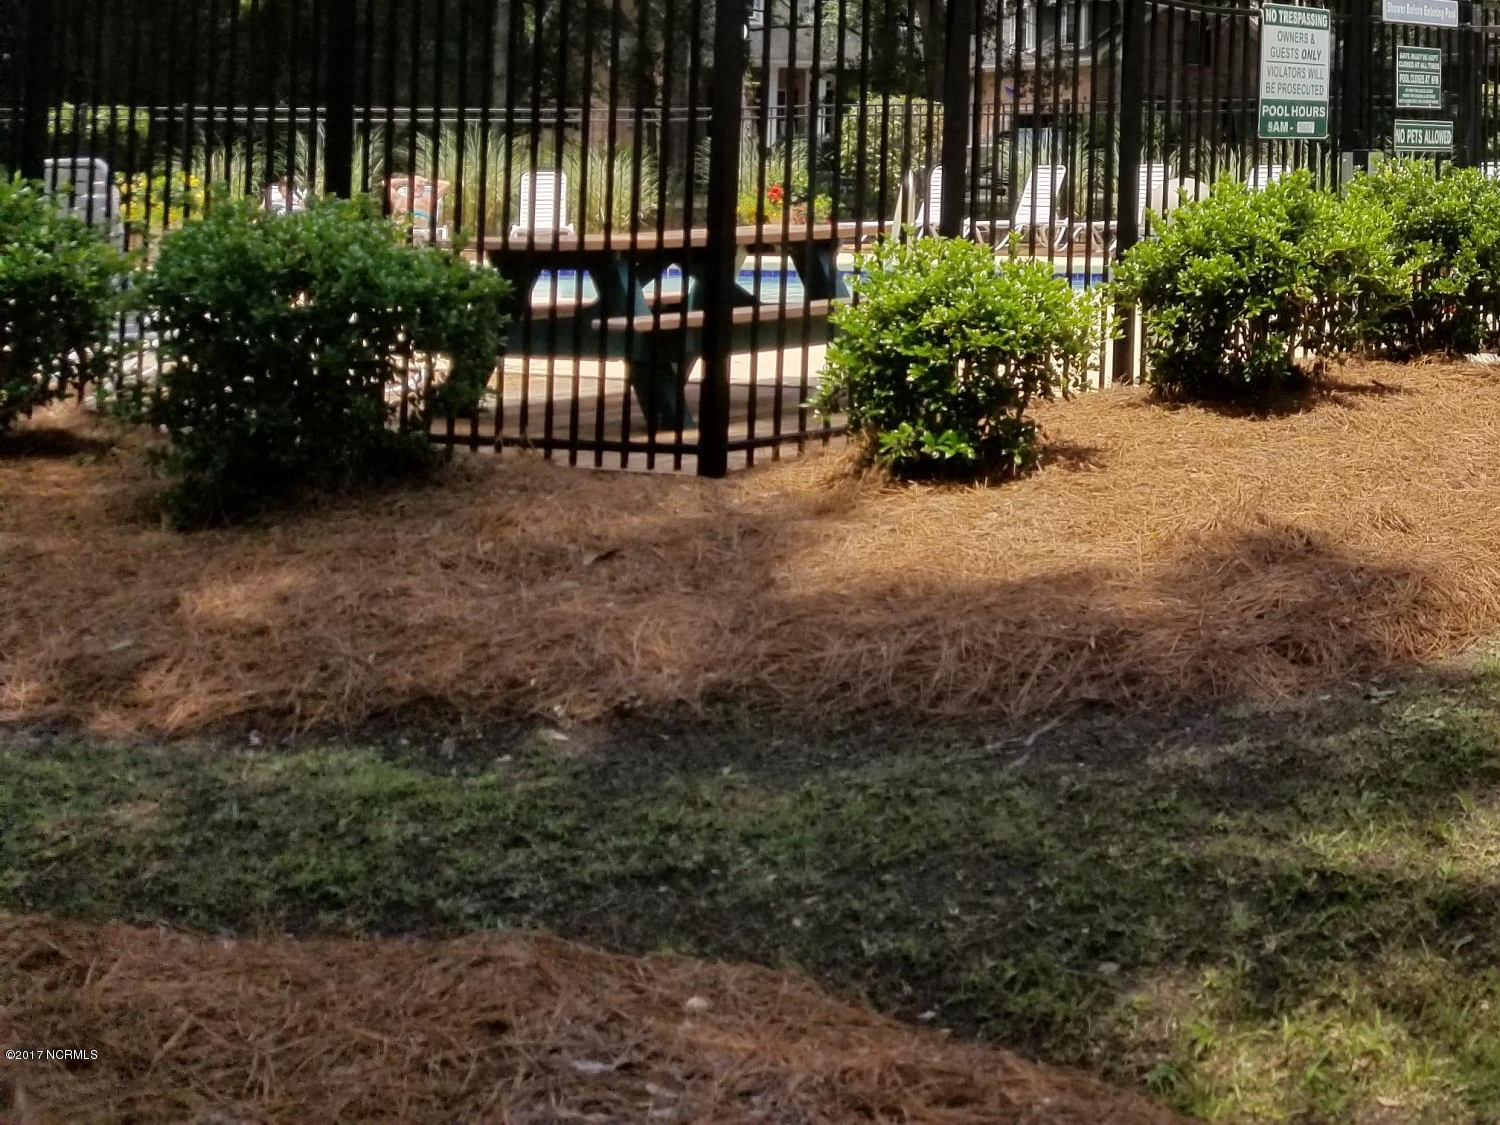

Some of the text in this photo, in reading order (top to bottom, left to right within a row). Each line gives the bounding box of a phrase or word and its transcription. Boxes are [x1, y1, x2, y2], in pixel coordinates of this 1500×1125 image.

[1265, 8, 1328, 27] NO TRESPASSING
[1387, 1, 1456, 20] Shower Before Entering Pool
[1277, 30, 1315, 44] OWNERS &
[1270, 46, 1322, 61] GUESTS ONLY
[1266, 65, 1324, 80] VIOLATORS WILL
[1414, 61, 1420, 69] AT
[1424, 74, 1431, 85] AT
[1265, 81, 1324, 96] BE PROSECUTED
[1262, 105, 1326, 118] POOL HOURS
[1267, 121, 1289, 133] 9AM
[1395, 128, 1452, 145] NO PETS ALLOWED
